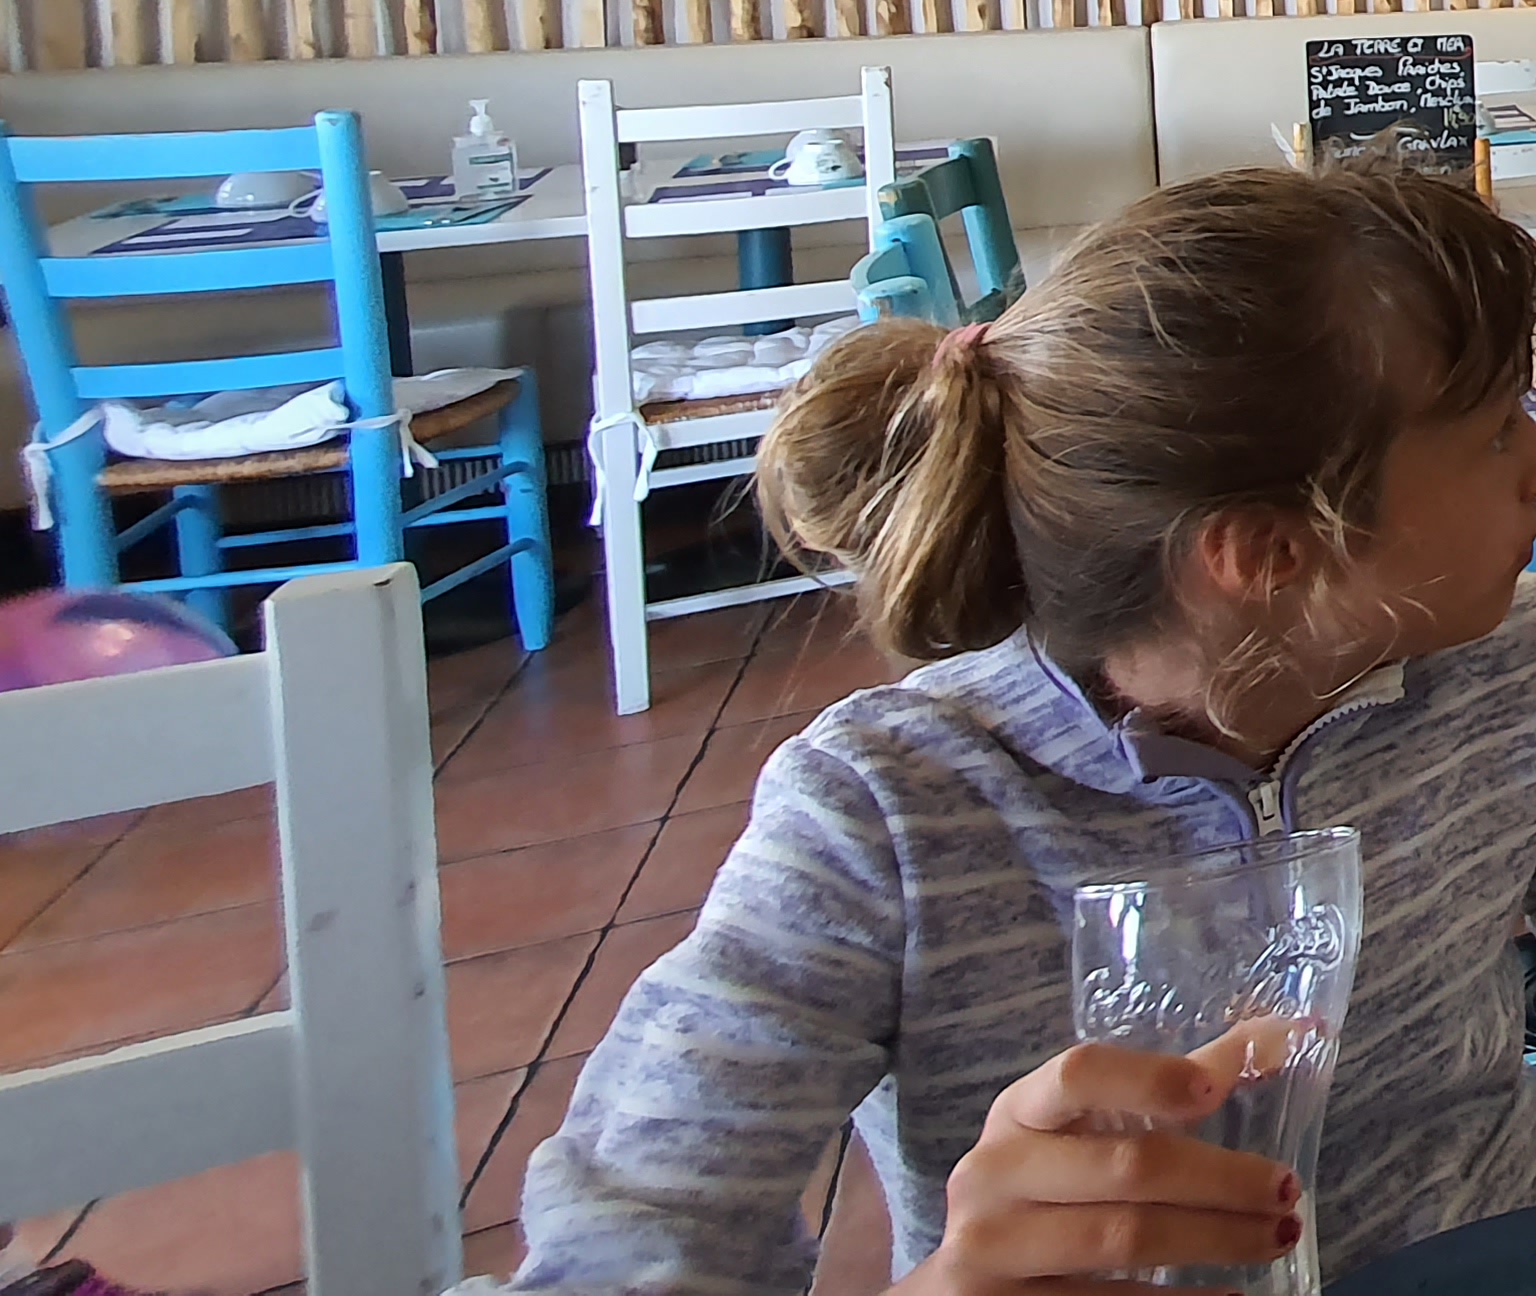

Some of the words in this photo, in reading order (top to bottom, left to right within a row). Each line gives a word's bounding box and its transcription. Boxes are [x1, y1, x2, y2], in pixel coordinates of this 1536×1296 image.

[1318, 41, 1344, 58] LA
[1351, 39, 1402, 56] TERRE
[1437, 36, 1465, 52] MER
